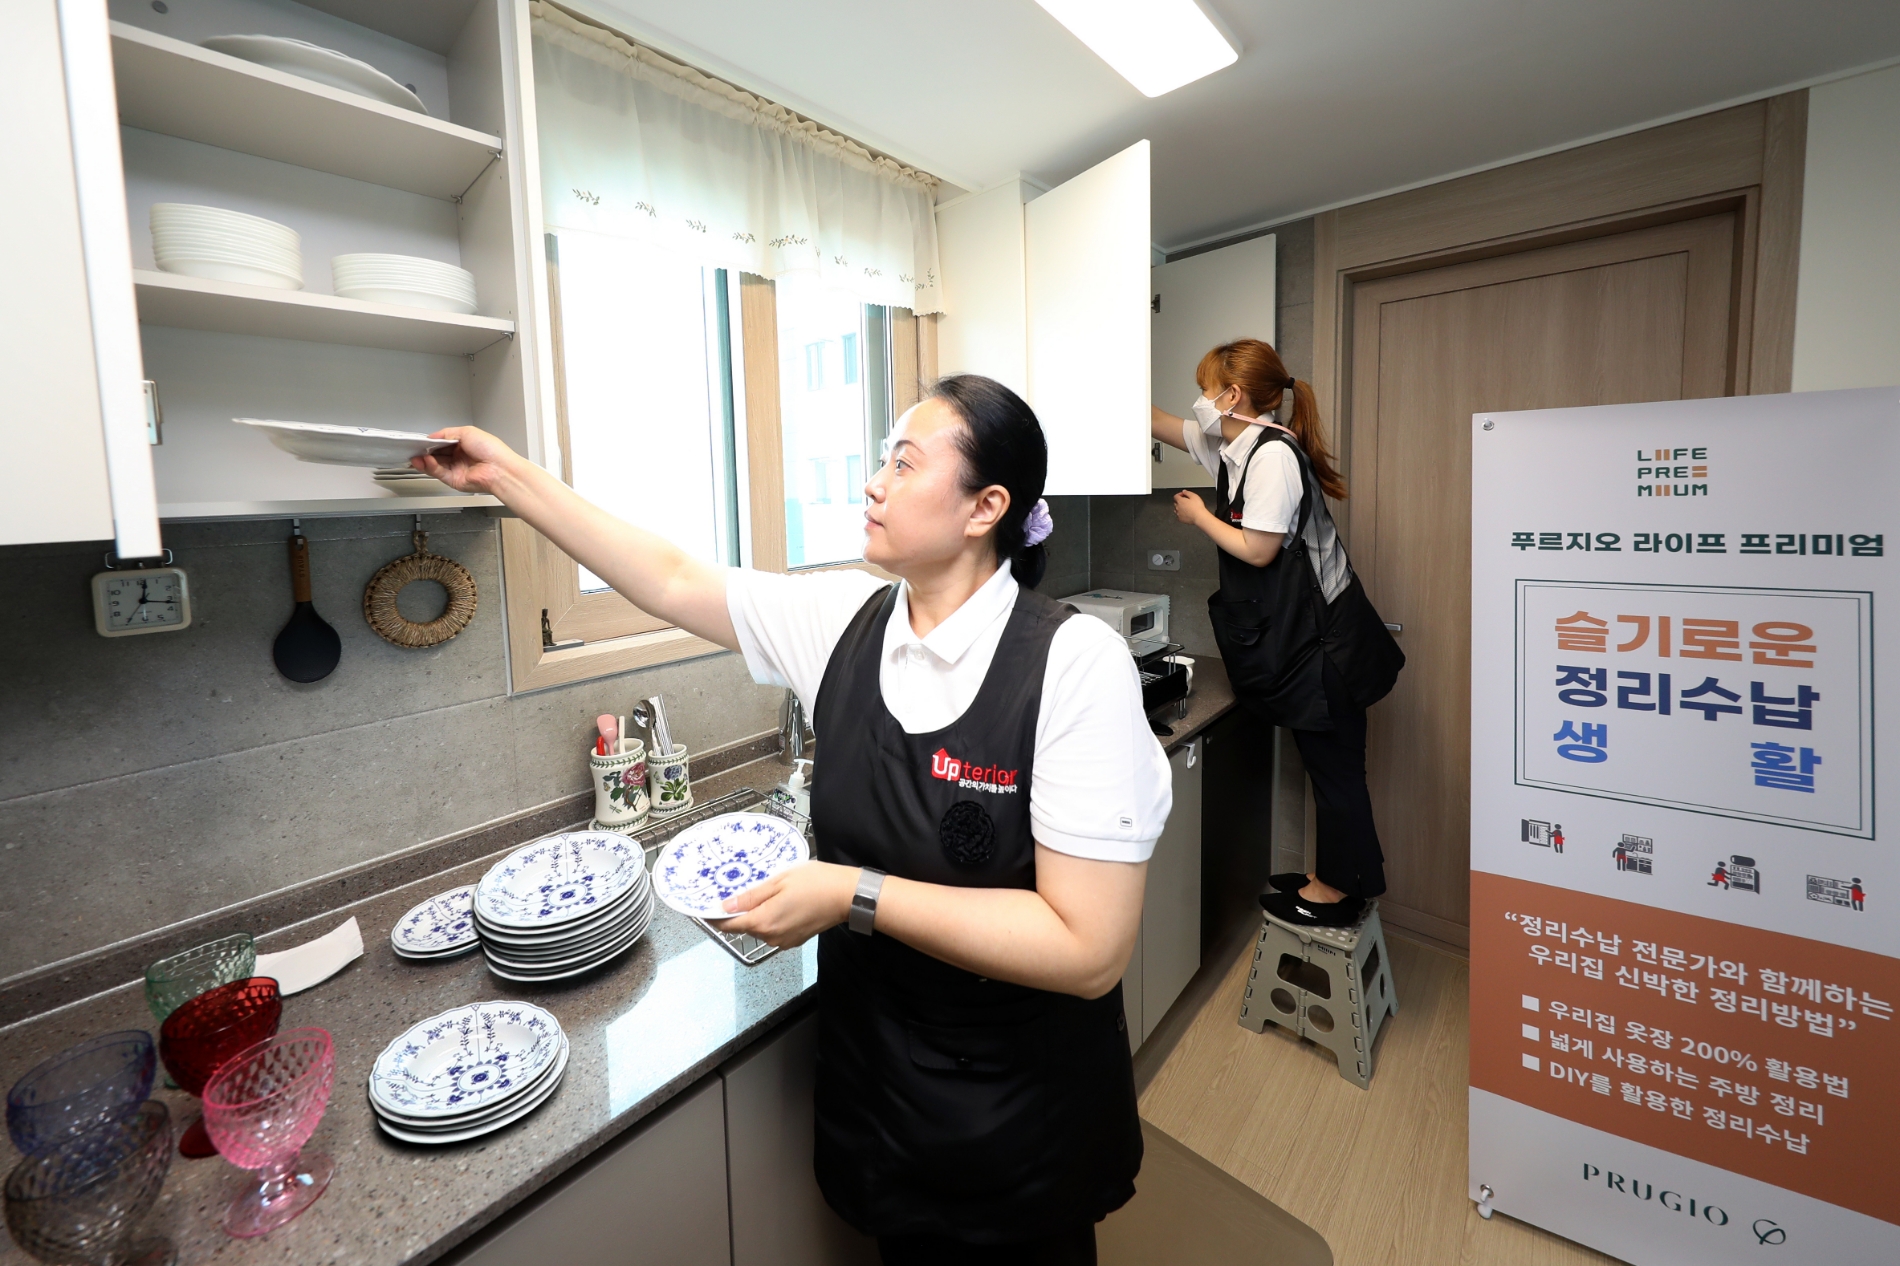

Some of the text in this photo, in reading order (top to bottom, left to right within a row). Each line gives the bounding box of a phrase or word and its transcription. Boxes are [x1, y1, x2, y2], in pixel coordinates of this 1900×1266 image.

[1510, 531, 1884, 557] 푸르지오 라이프 프리미엄
[1554, 610, 1817, 669] 슬기로운
[1555, 664, 1821, 731] 정리수납
[932, 753, 1018, 786] Upterior
[1528, 943, 1604, 981] 우리집
[1615, 964, 1700, 1005] 신박한
[1631, 938, 1749, 987] 전문가와
[1758, 967, 1895, 1022] 함께하는
[1548, 1000, 1849, 1099] 우리집 옷장 200% 활용법
[1549, 1030, 1825, 1126] 넓게 사용하는 주방 정리
[1549, 1060, 1811, 1155] DIY를 활용한 정리수납
[1582, 1162, 1730, 1227] PRUGIO
